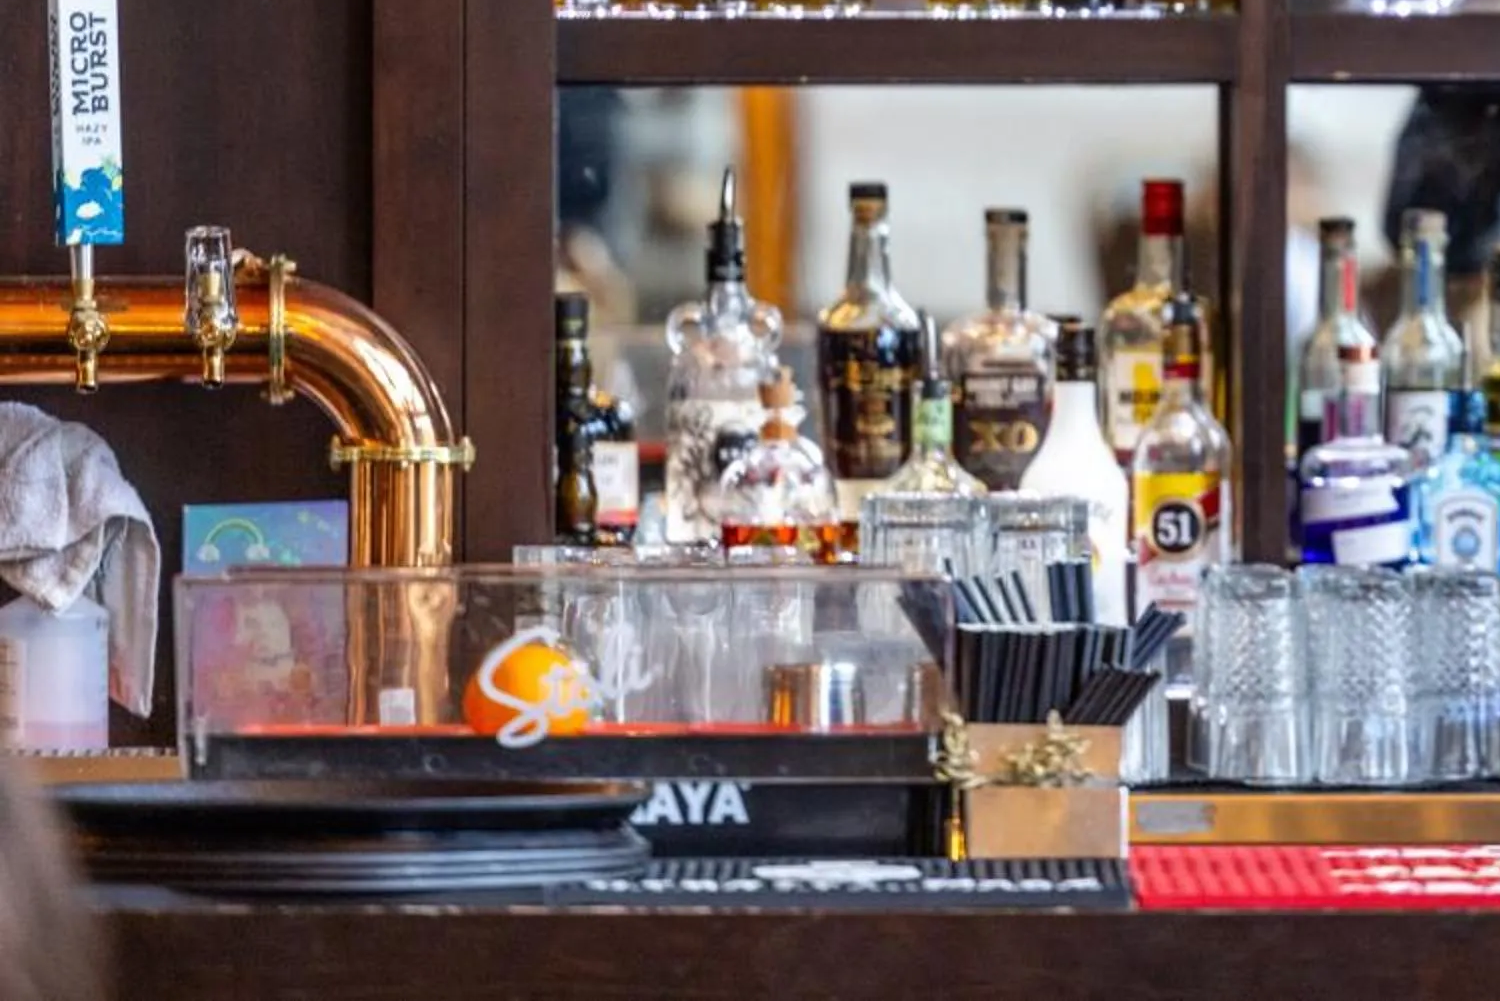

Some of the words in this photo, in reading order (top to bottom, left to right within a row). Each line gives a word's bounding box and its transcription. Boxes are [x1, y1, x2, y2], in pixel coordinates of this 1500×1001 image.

[70, 11, 89, 115] MICRO
[89, 11, 108, 114] BURST
[969, 420, 1038, 454] XO
[1157, 510, 1192, 545] 51
